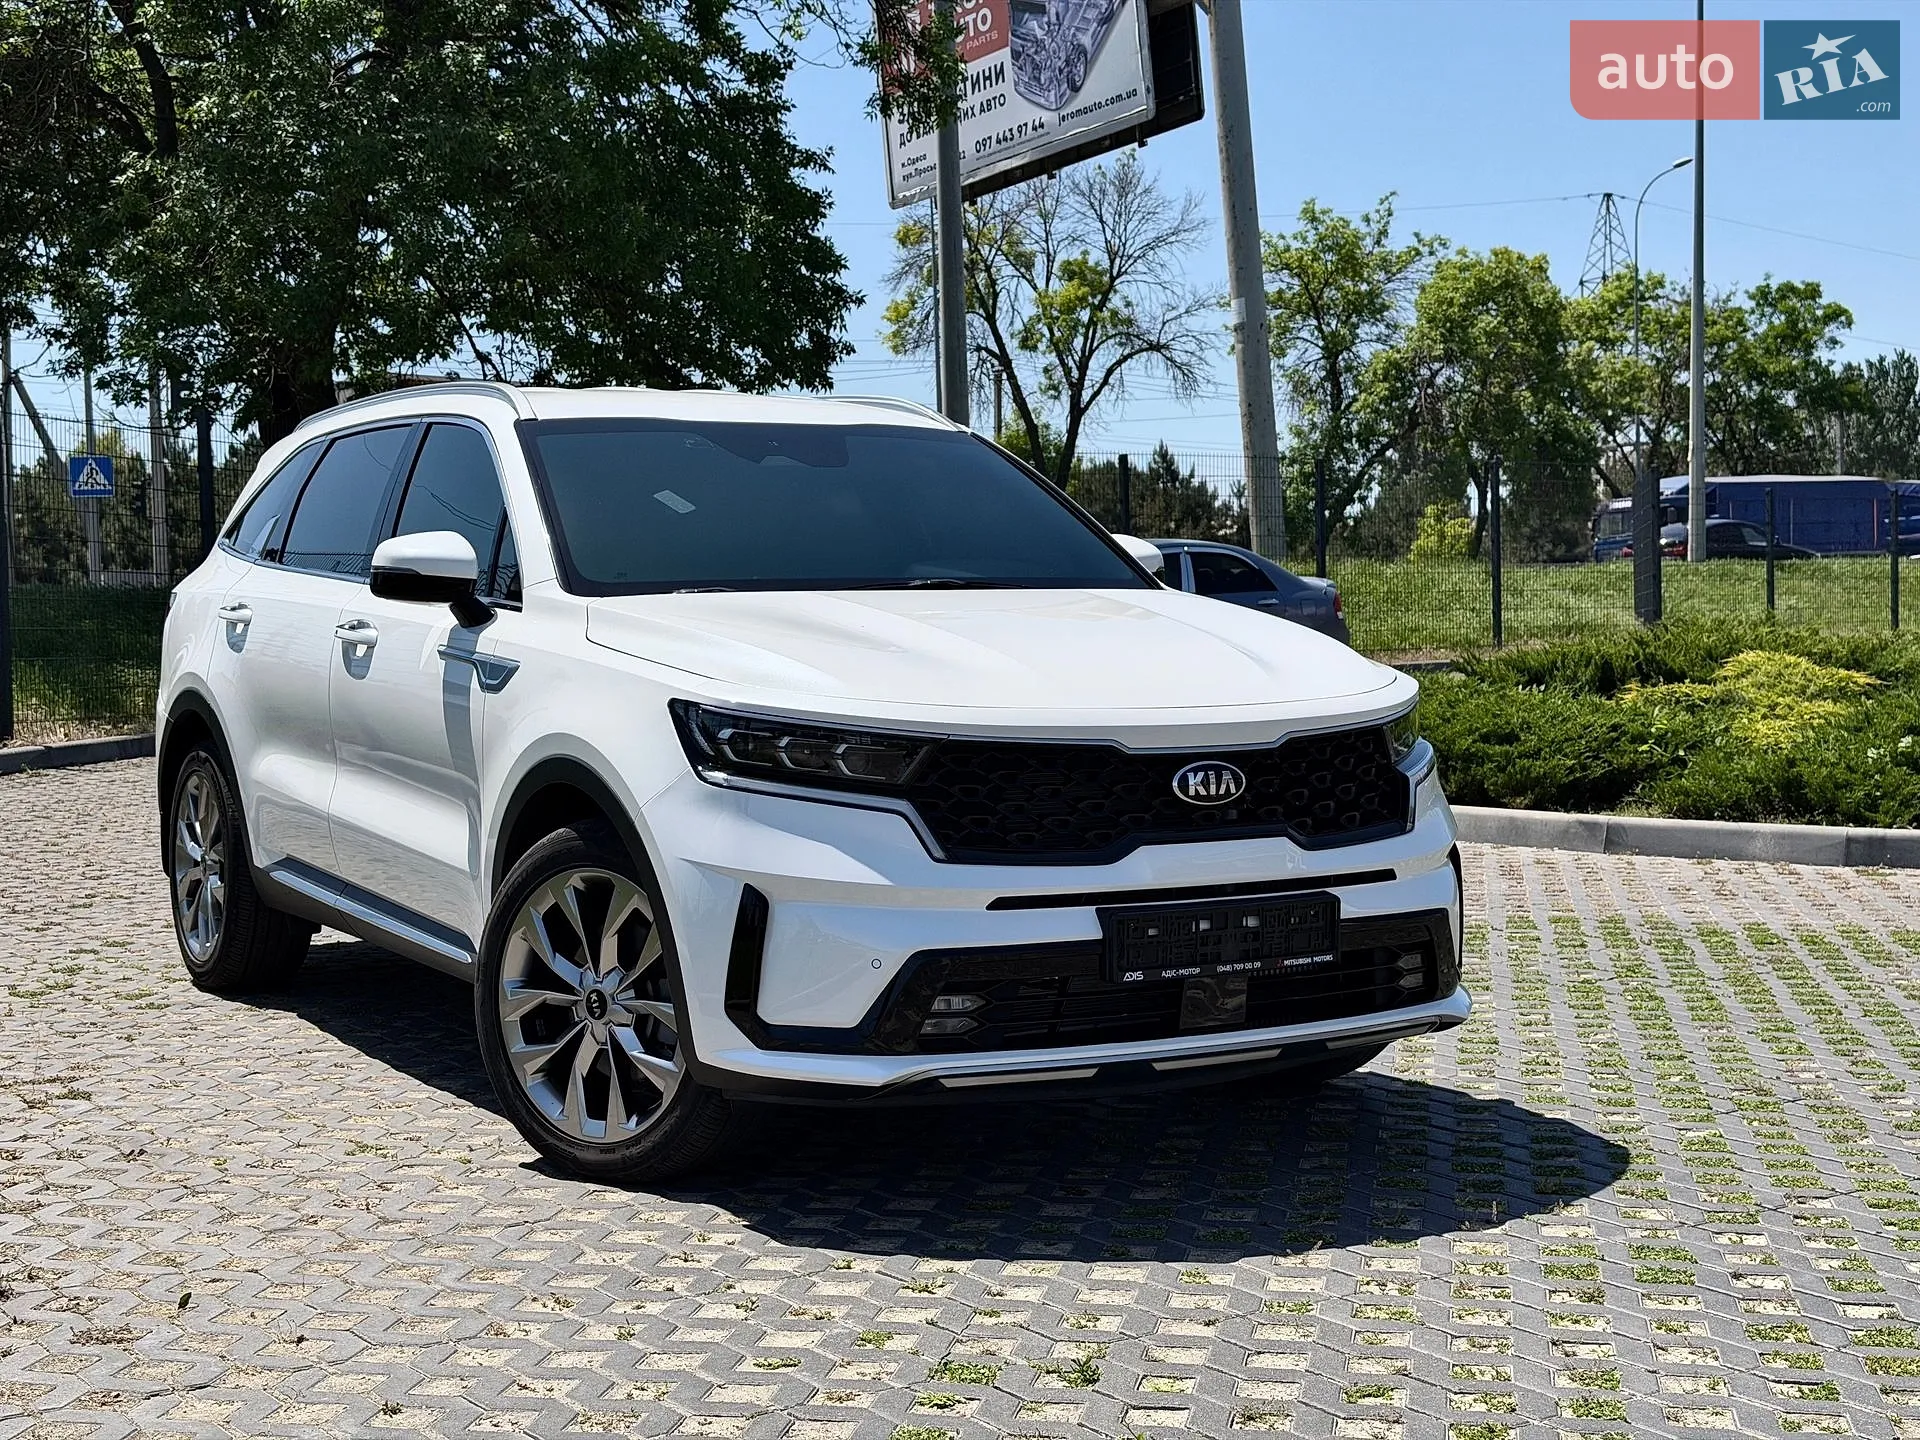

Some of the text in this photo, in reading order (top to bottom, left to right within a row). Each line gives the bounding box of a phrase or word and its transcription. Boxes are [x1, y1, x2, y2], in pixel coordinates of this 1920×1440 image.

[966, 30, 998, 50] PARTS
[979, 93, 1006, 116] АВТО
[1058, 88, 1138, 126] jeromauto.com.ua
[974, 135, 992, 153] 097
[995, 128, 1015, 144] 443
[1017, 122, 1029, 138] 97
[1031, 116, 1045, 132] 44
[1186, 770, 1237, 796] KIA
[1216, 964, 1232, 973] (048)
[1233, 963, 1244, 971] 709
[1283, 954, 1334, 967] MITSUBISHI MOTORS
[1123, 971, 1144, 981] ADIS
